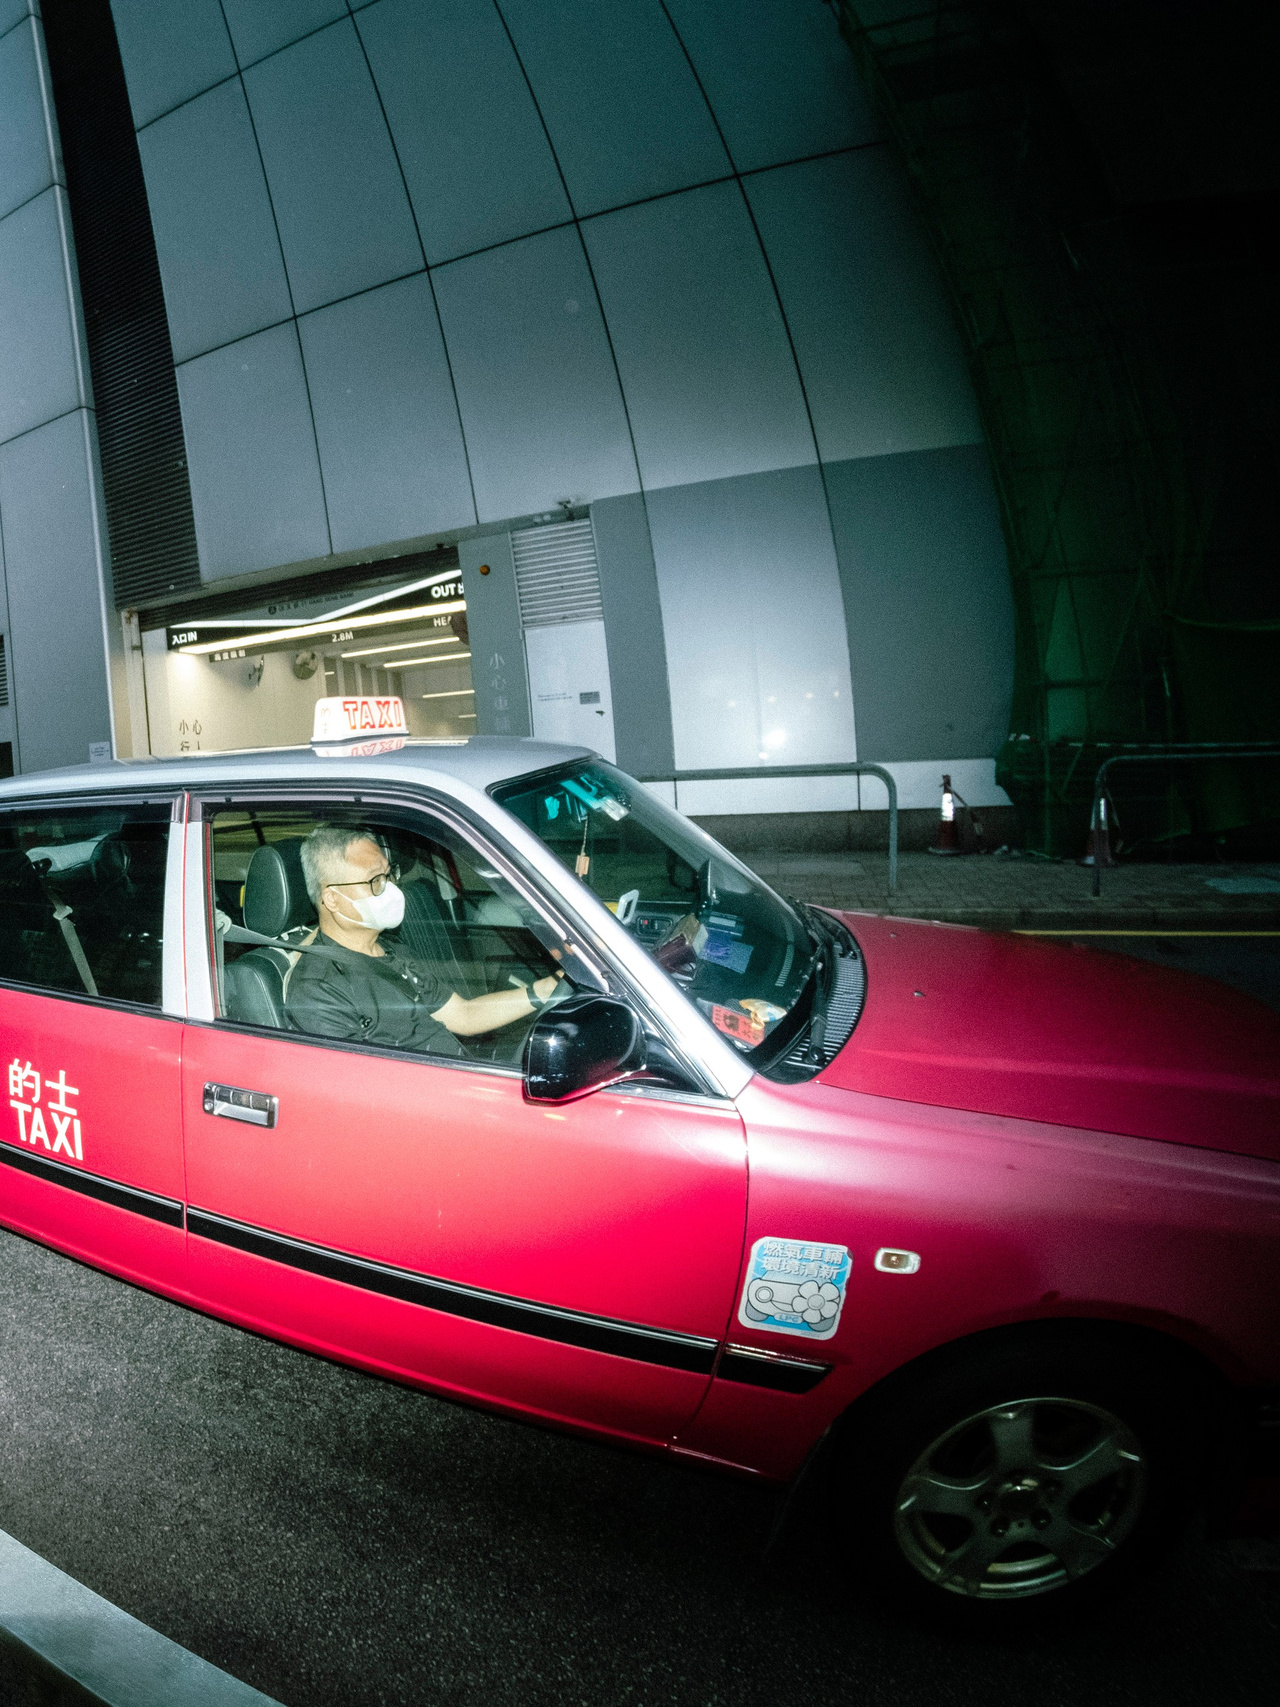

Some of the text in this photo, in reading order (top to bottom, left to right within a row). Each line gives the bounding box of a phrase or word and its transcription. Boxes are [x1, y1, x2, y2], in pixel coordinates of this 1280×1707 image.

[431, 583, 456, 598] OUT
[172, 631, 198, 645] 入口 IN
[332, 631, 354, 643] 2.8M
[342, 700, 402, 730] TAXI
[179, 719, 202, 735] 小心
[8, 1058, 79, 1116] 的士
[10, 1099, 83, 1161] TAXI
[763, 1241, 844, 1264] 燃氣車輛
[762, 1256, 841, 1280] 環境清新
